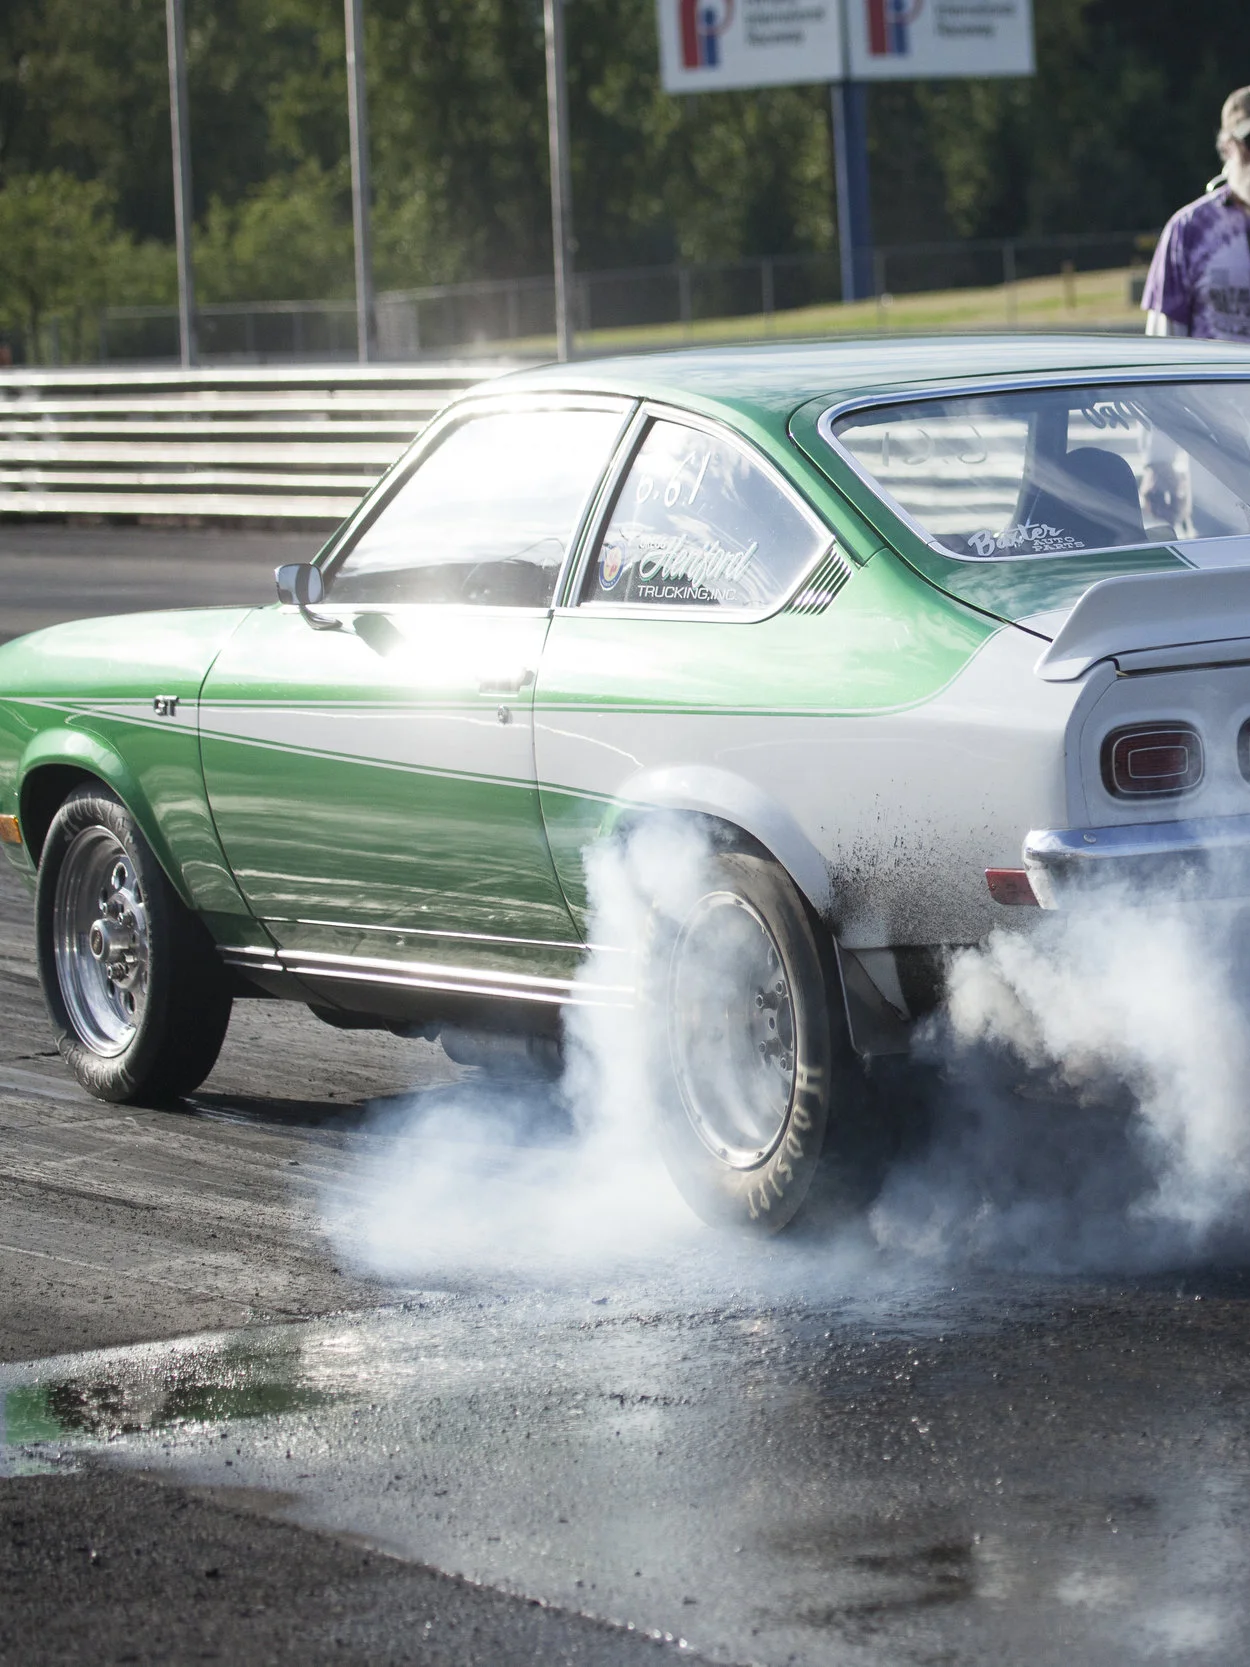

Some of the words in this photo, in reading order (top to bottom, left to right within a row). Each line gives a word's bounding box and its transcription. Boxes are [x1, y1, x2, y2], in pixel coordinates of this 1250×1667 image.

[968, 523, 1065, 557] Baxter
[1031, 541, 1085, 552] PARTS
[1033, 536, 1075, 546] AUTO
[153, 695, 179, 717] GT
